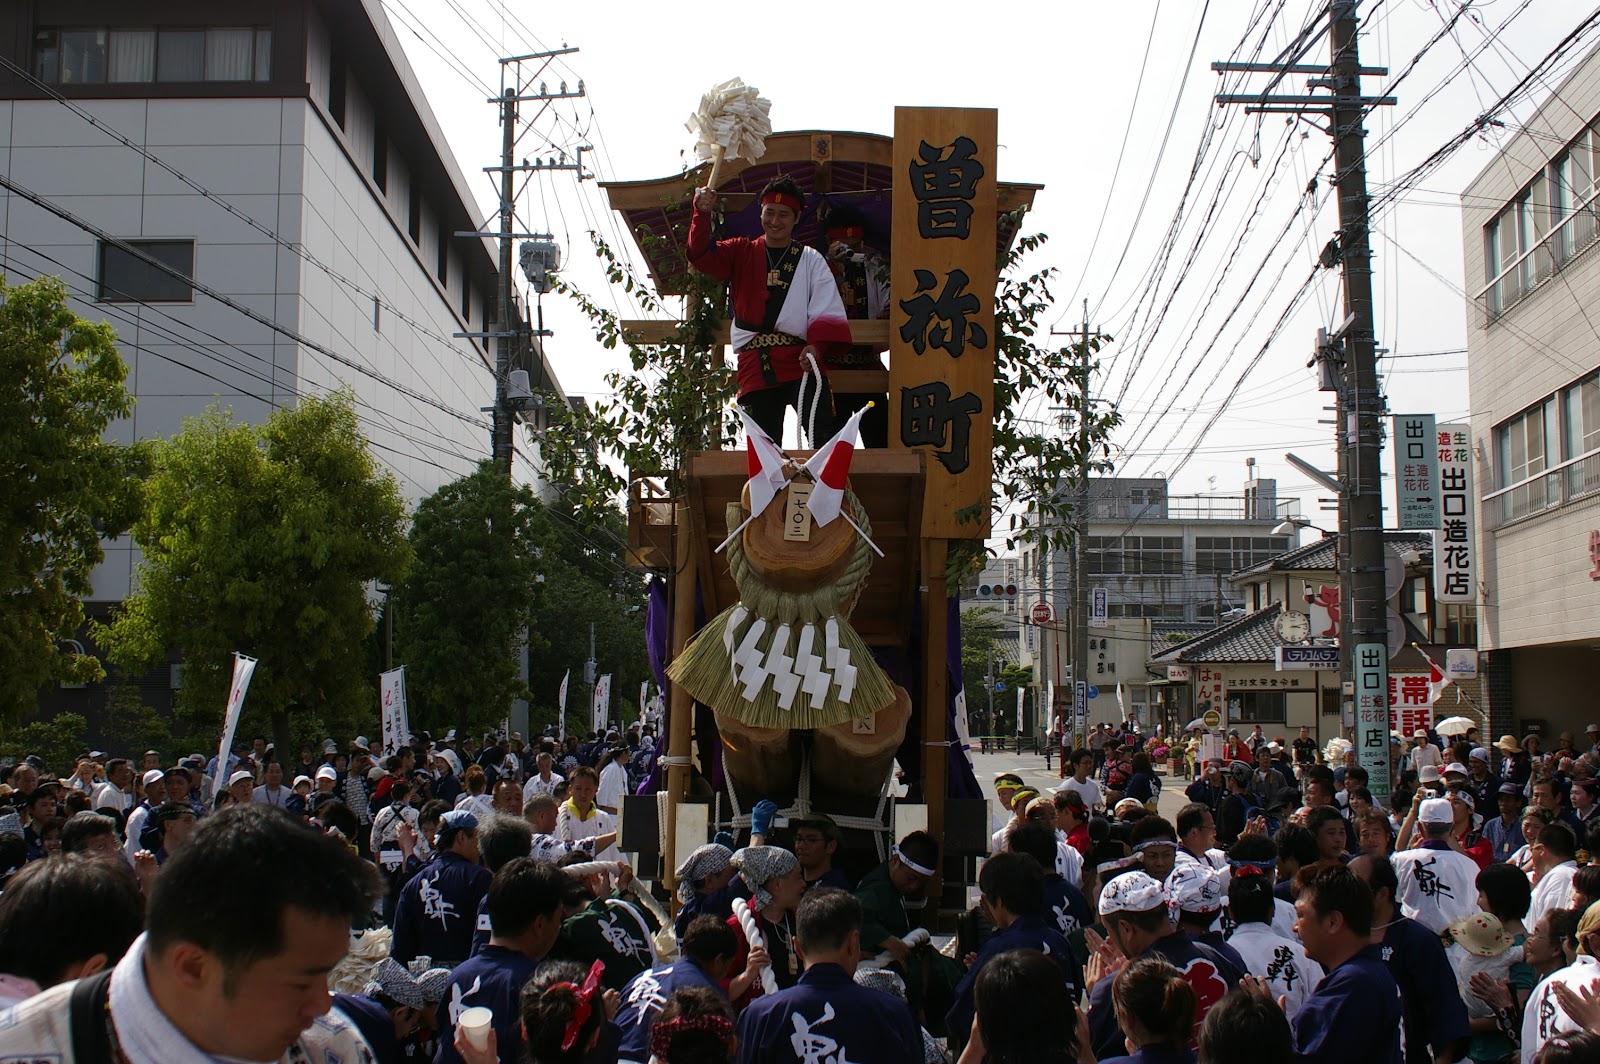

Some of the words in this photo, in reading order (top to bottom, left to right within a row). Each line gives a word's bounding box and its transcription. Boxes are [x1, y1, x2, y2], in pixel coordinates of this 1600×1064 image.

[1406, 420, 1424, 459] 出口
[1438, 432, 1452, 462] 造花
[1453, 432, 1467, 462] 生花
[1404, 464, 1416, 491] 生花
[1417, 464, 1429, 491] 造花
[1441, 467, 1470, 595] 出口造花店
[1362, 649, 1380, 689] 出口
[1360, 695, 1372, 723] 生花
[1373, 694, 1385, 723] 造花
[1365, 729, 1383, 748] 店
